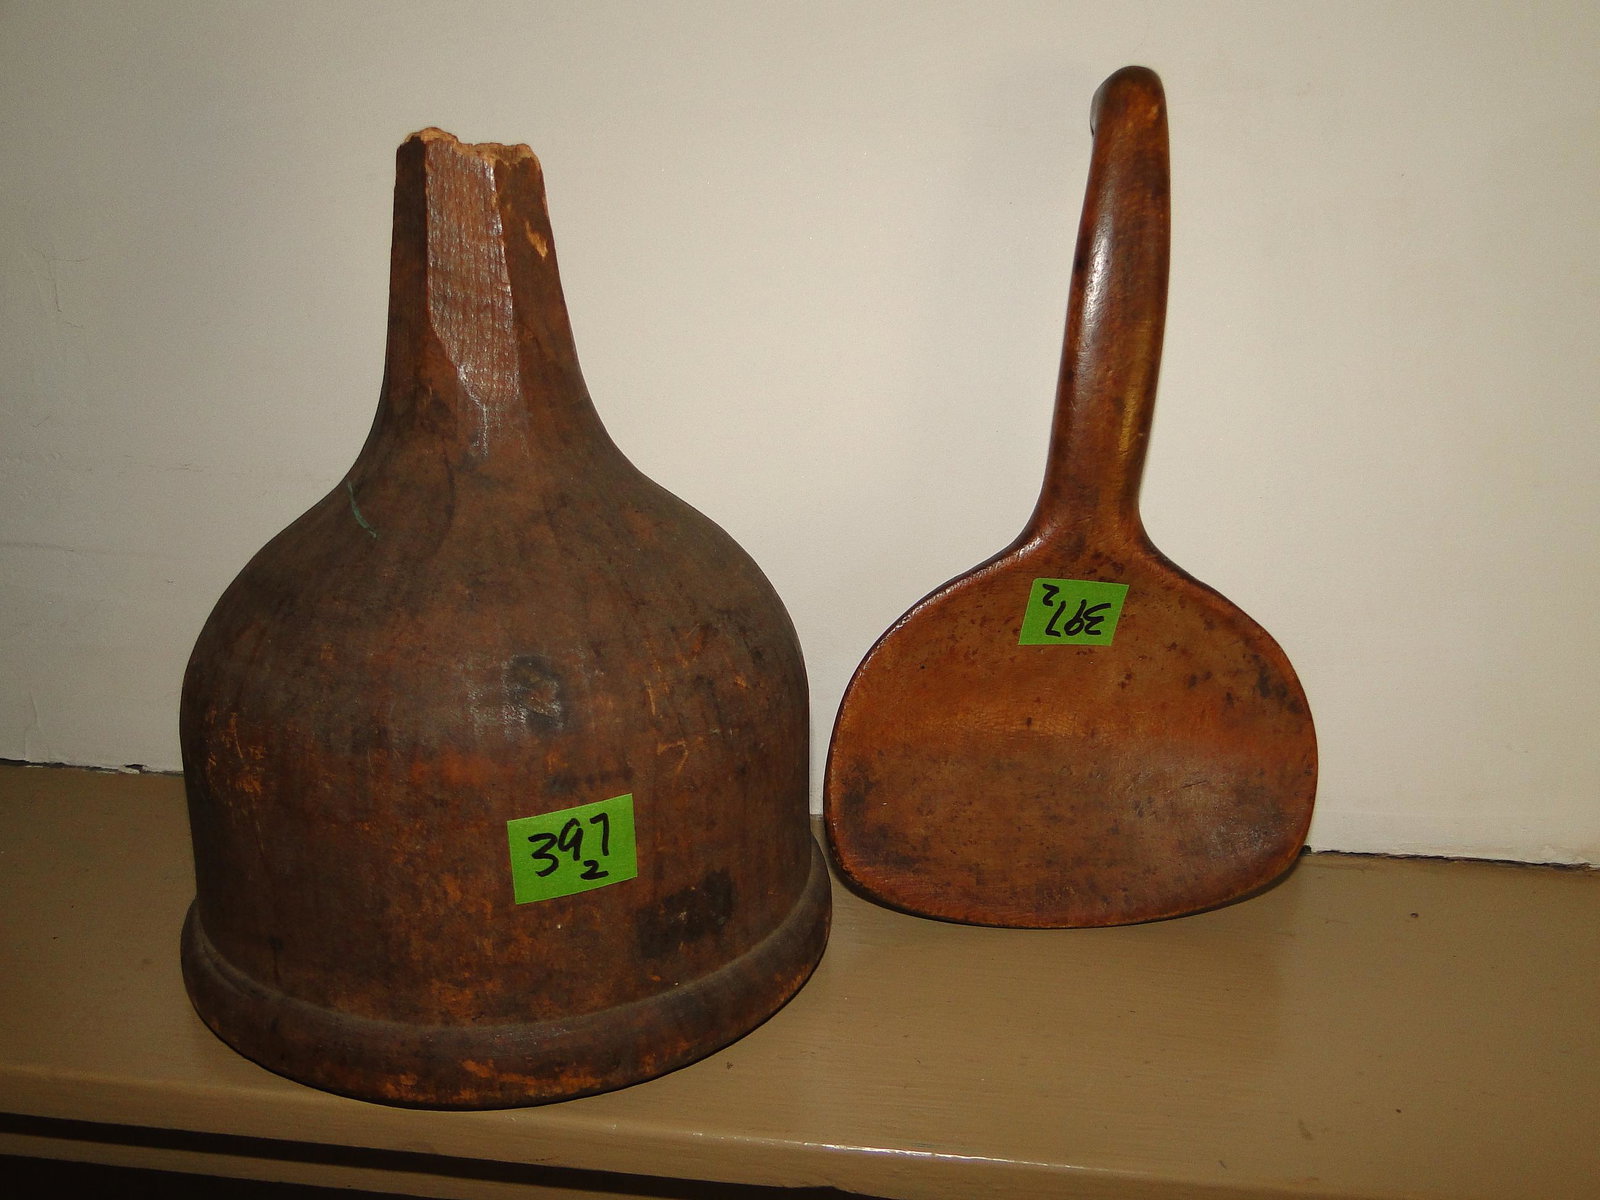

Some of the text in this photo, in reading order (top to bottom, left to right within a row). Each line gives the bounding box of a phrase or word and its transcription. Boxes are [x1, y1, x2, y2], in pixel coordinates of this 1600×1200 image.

[1042, 583, 1060, 607] 2
[1044, 598, 1112, 638] 397
[527, 812, 610, 877] 397
[580, 859, 609, 880] 2
